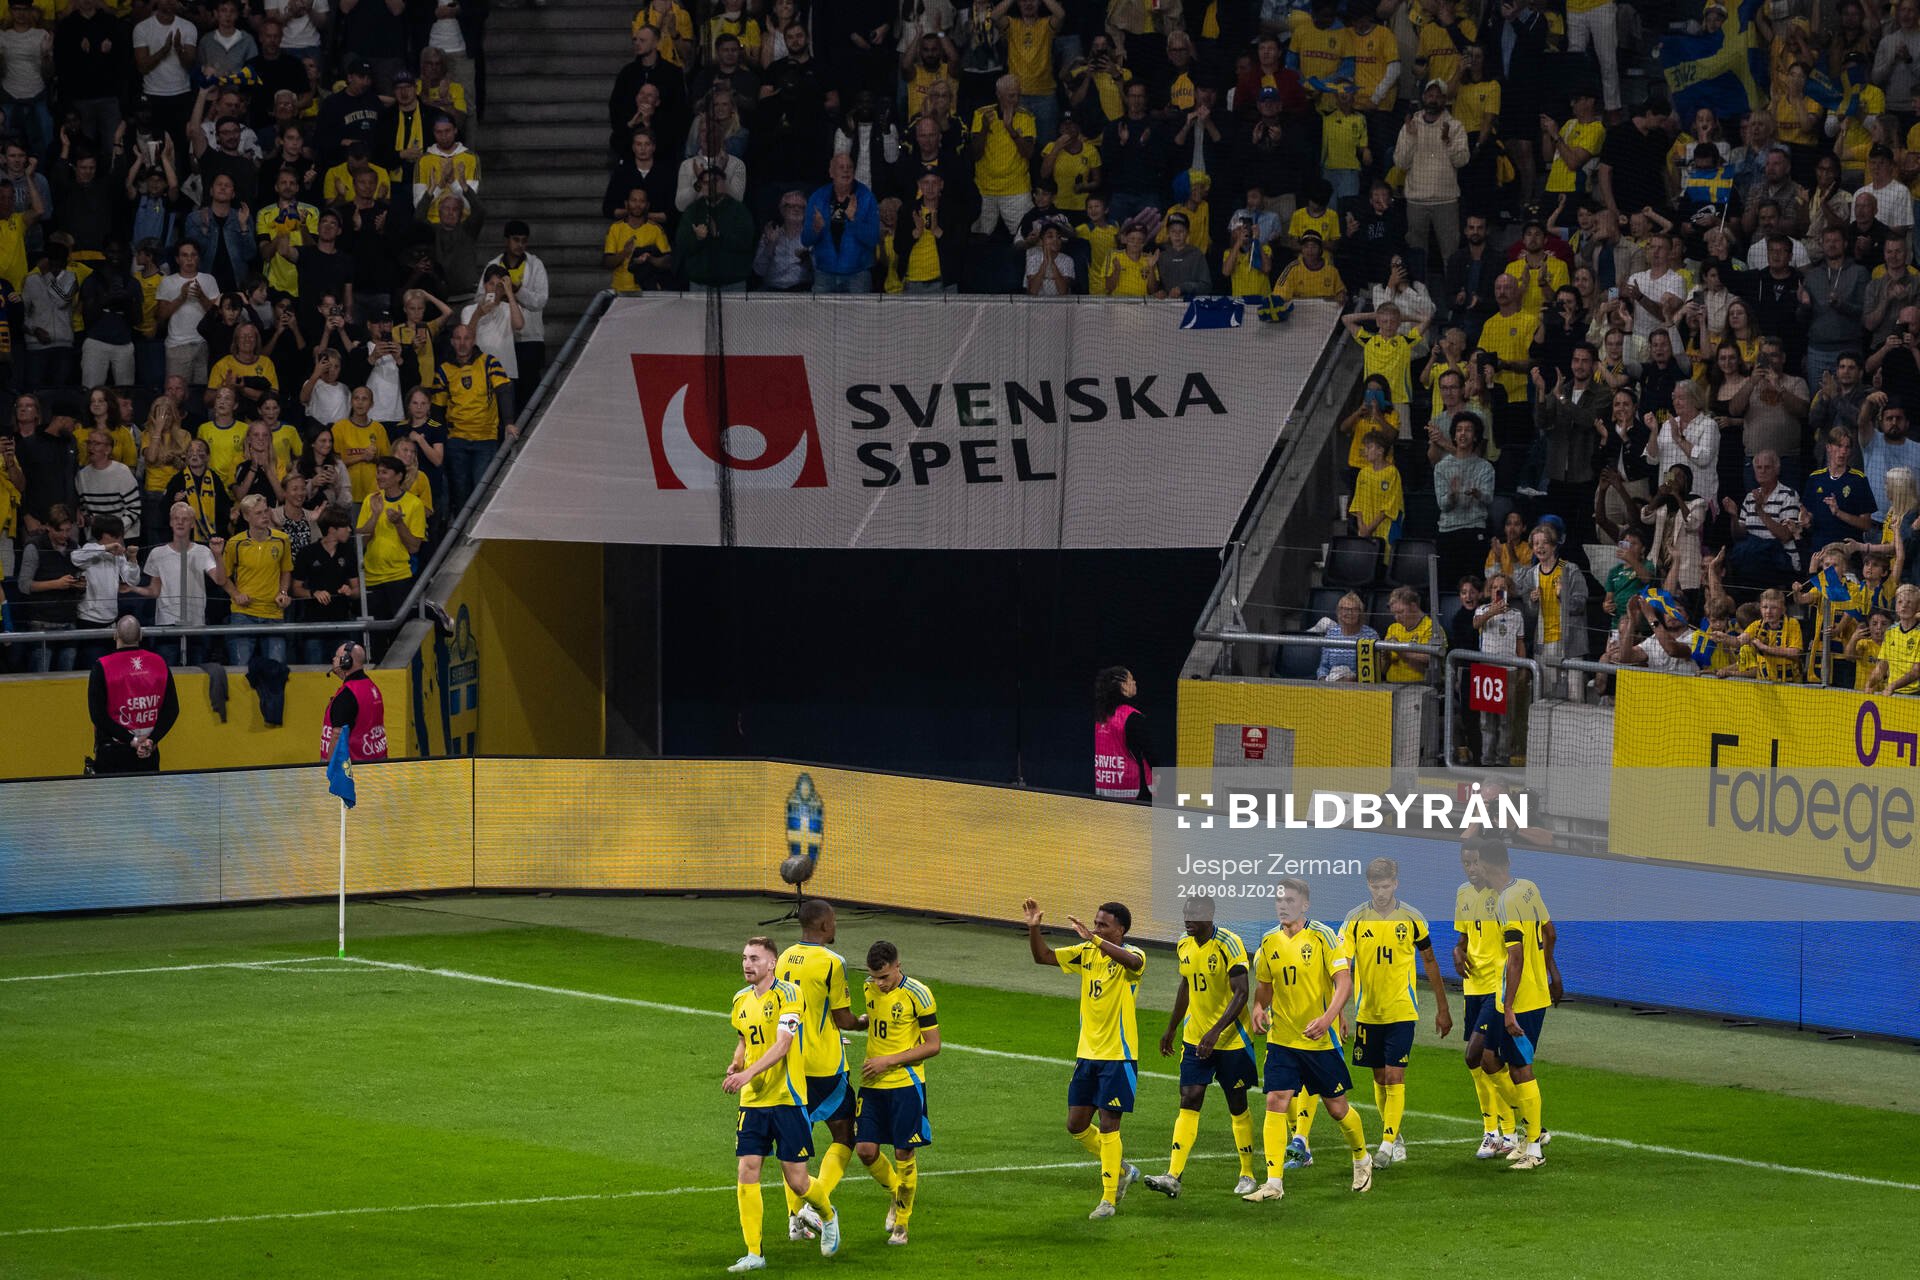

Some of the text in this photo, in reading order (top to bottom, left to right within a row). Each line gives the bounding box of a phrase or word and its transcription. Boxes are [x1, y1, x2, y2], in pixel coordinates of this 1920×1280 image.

[845, 372, 1228, 430] SVENSKA
[856, 438, 1057, 488] SPEL
[1361, 644, 1370, 683] RIG
[1473, 675, 1504, 703] 103
[1708, 733, 1915, 872] Fabege
[1376, 945, 1393, 965] 14
[1193, 972, 1207, 992] 13
[1283, 966, 1297, 986] 17
[1089, 979, 1102, 998] 16
[749, 1025, 765, 1045] 21
[873, 1018, 887, 1039] 18
